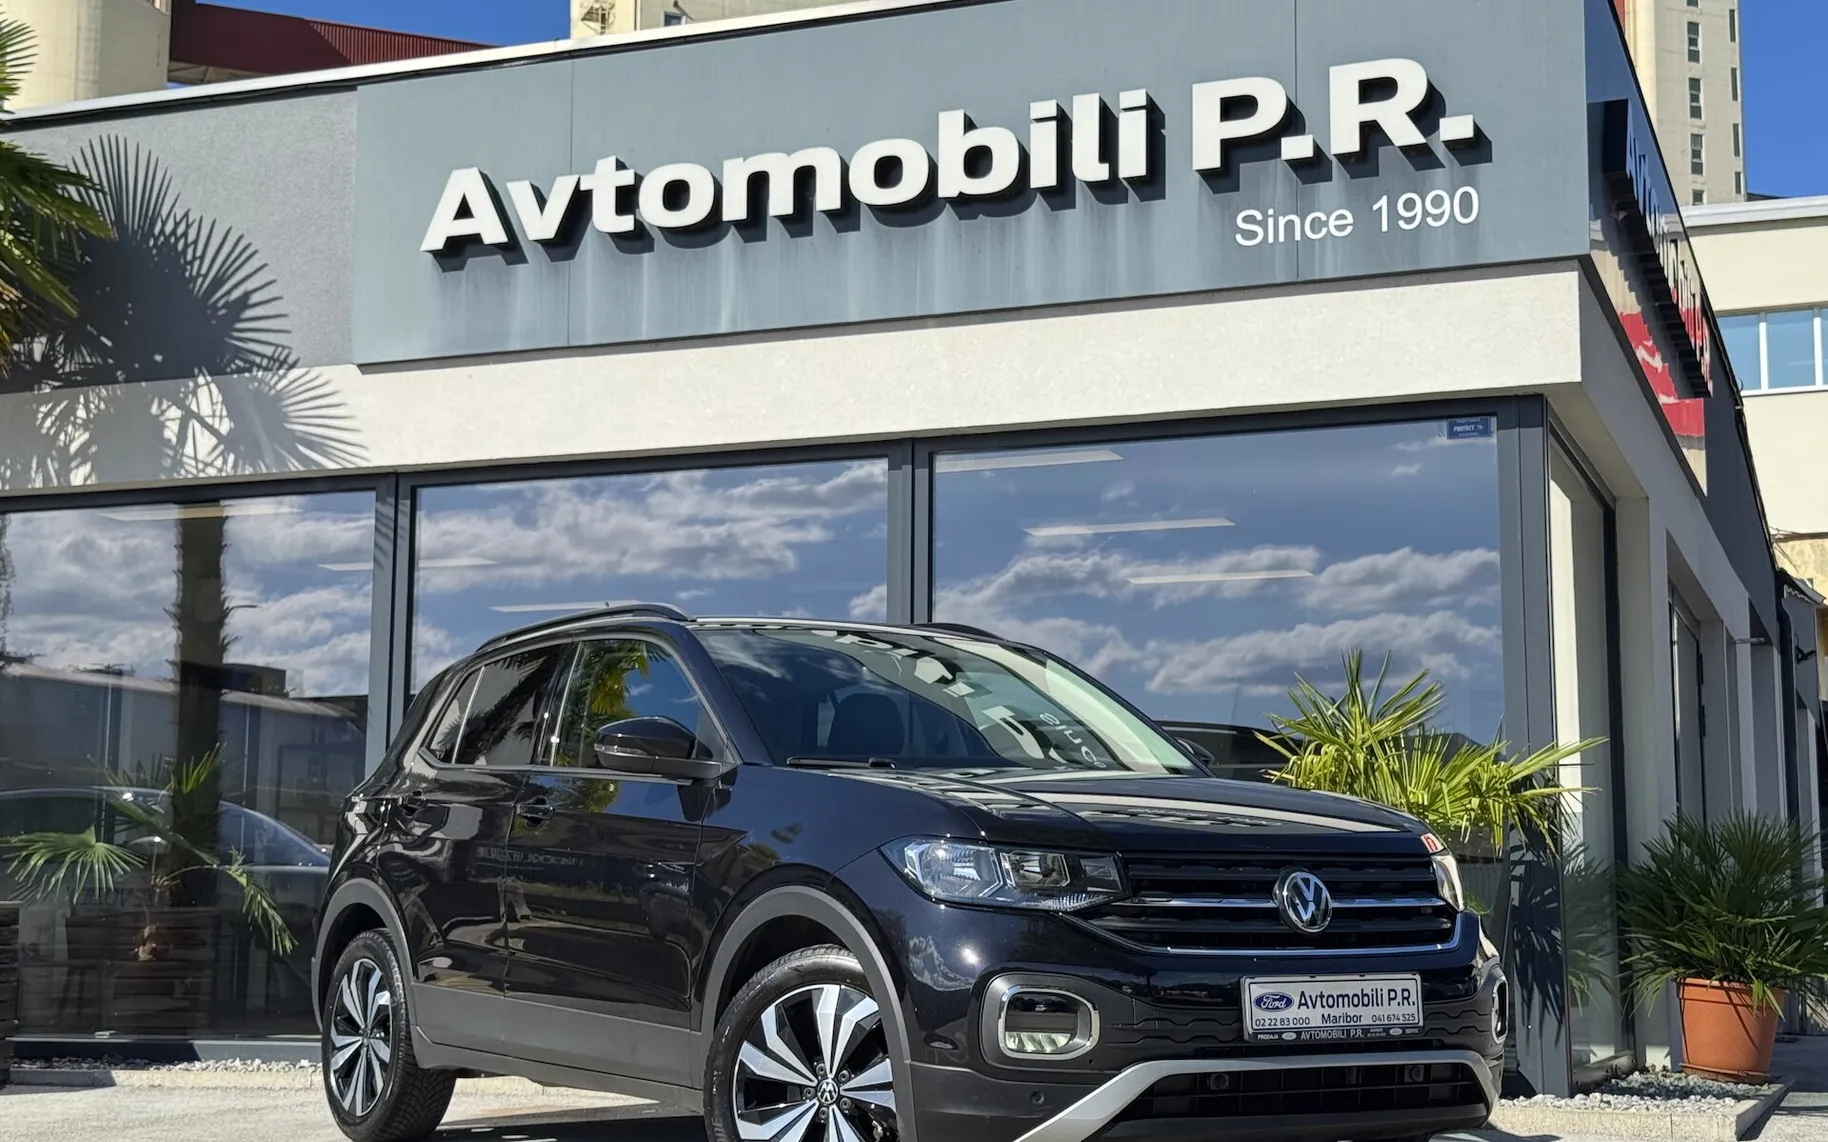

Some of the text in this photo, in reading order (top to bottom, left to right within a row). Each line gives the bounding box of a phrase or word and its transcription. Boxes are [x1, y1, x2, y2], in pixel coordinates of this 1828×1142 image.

[420, 58, 1475, 252] Avtomobili P.R.
[1235, 186, 1480, 247] Since 1990
[1260, 994, 1287, 1009] Ford
[1297, 987, 1416, 1010] Avtomobili P.R.
[1254, 1016, 1311, 1027] 02 22 83 000
[1321, 1011, 1363, 1025] Maribor
[1371, 1012, 1416, 1023] 041 674 525
[1300, 1029, 1347, 1040] AVTOMOBILI
[1350, 1028, 1365, 1038] P.R.
